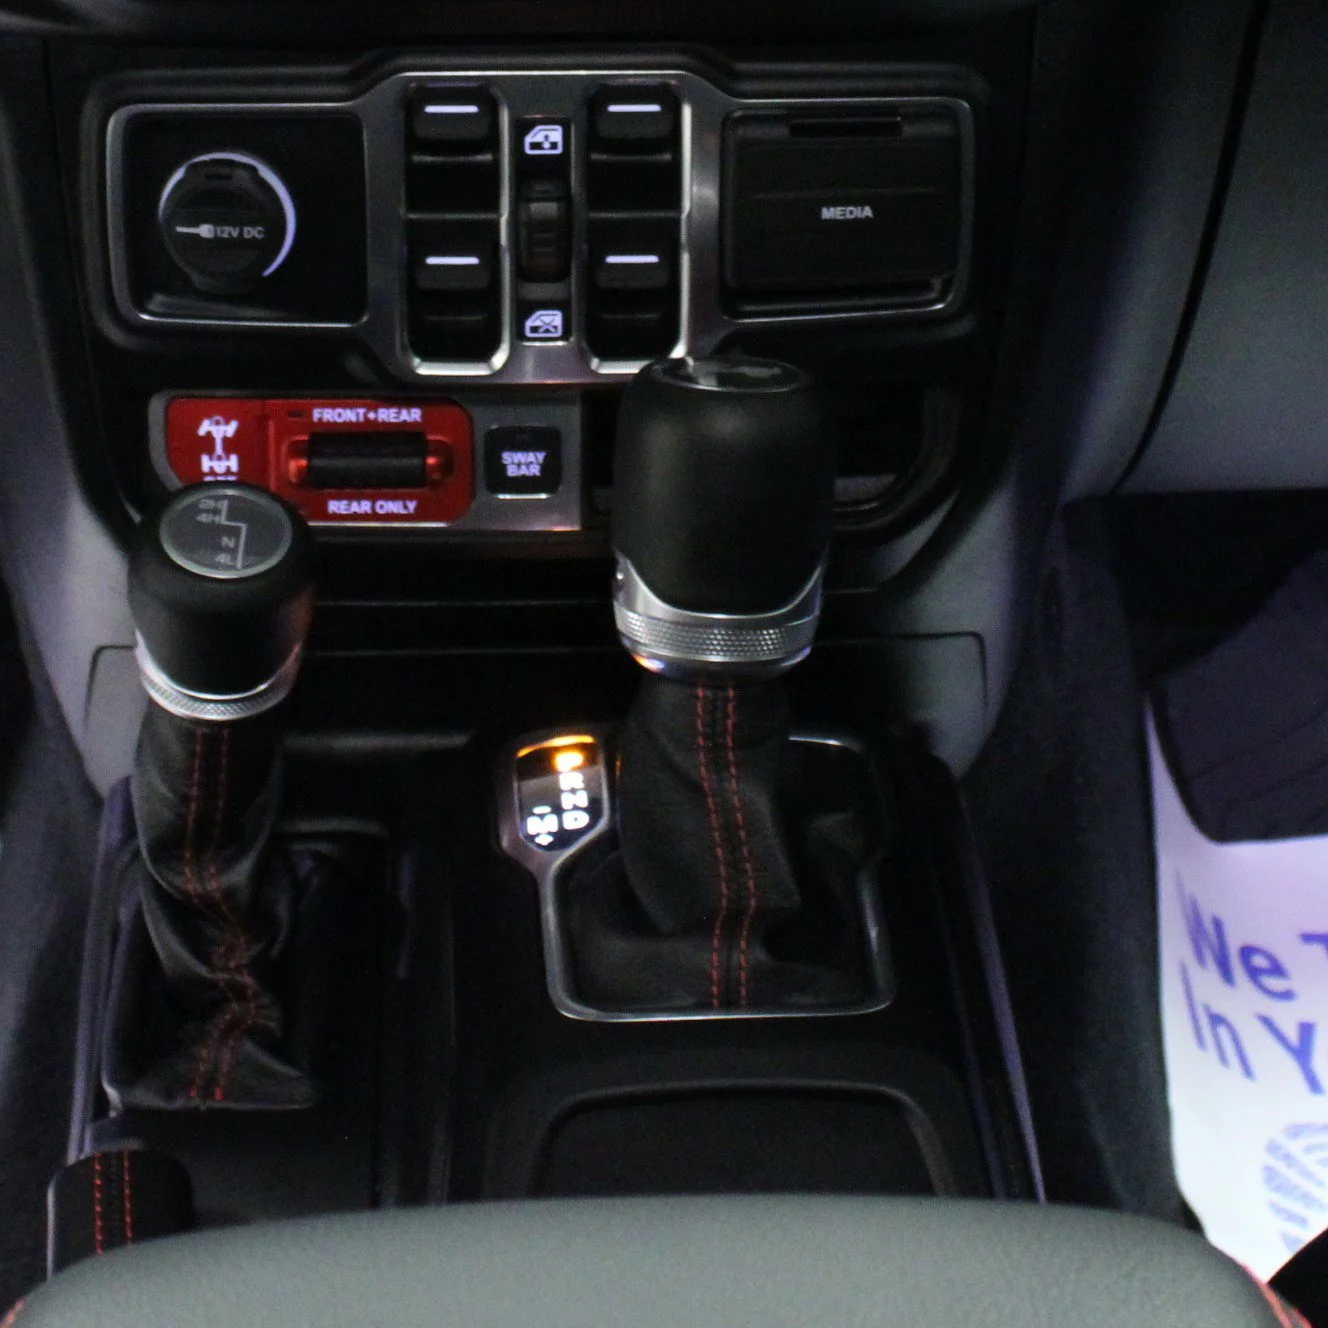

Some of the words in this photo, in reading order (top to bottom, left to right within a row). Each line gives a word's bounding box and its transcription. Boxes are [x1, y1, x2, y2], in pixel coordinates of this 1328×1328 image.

[821, 206, 873, 220] MEDIA
[215, 227, 240, 239] 12V
[243, 227, 265, 239] DC
[502, 451, 546, 465] SWAY
[507, 465, 541, 476] BAR
[328, 500, 371, 514] REAR
[376, 500, 417, 514] ONLY
[221, 536, 235, 548] N
[561, 790, 588, 809] N
[527, 814, 558, 835] M
[562, 810, 589, 830] D
[1175, 869, 1297, 1002] We
[1179, 958, 1256, 1082] In
